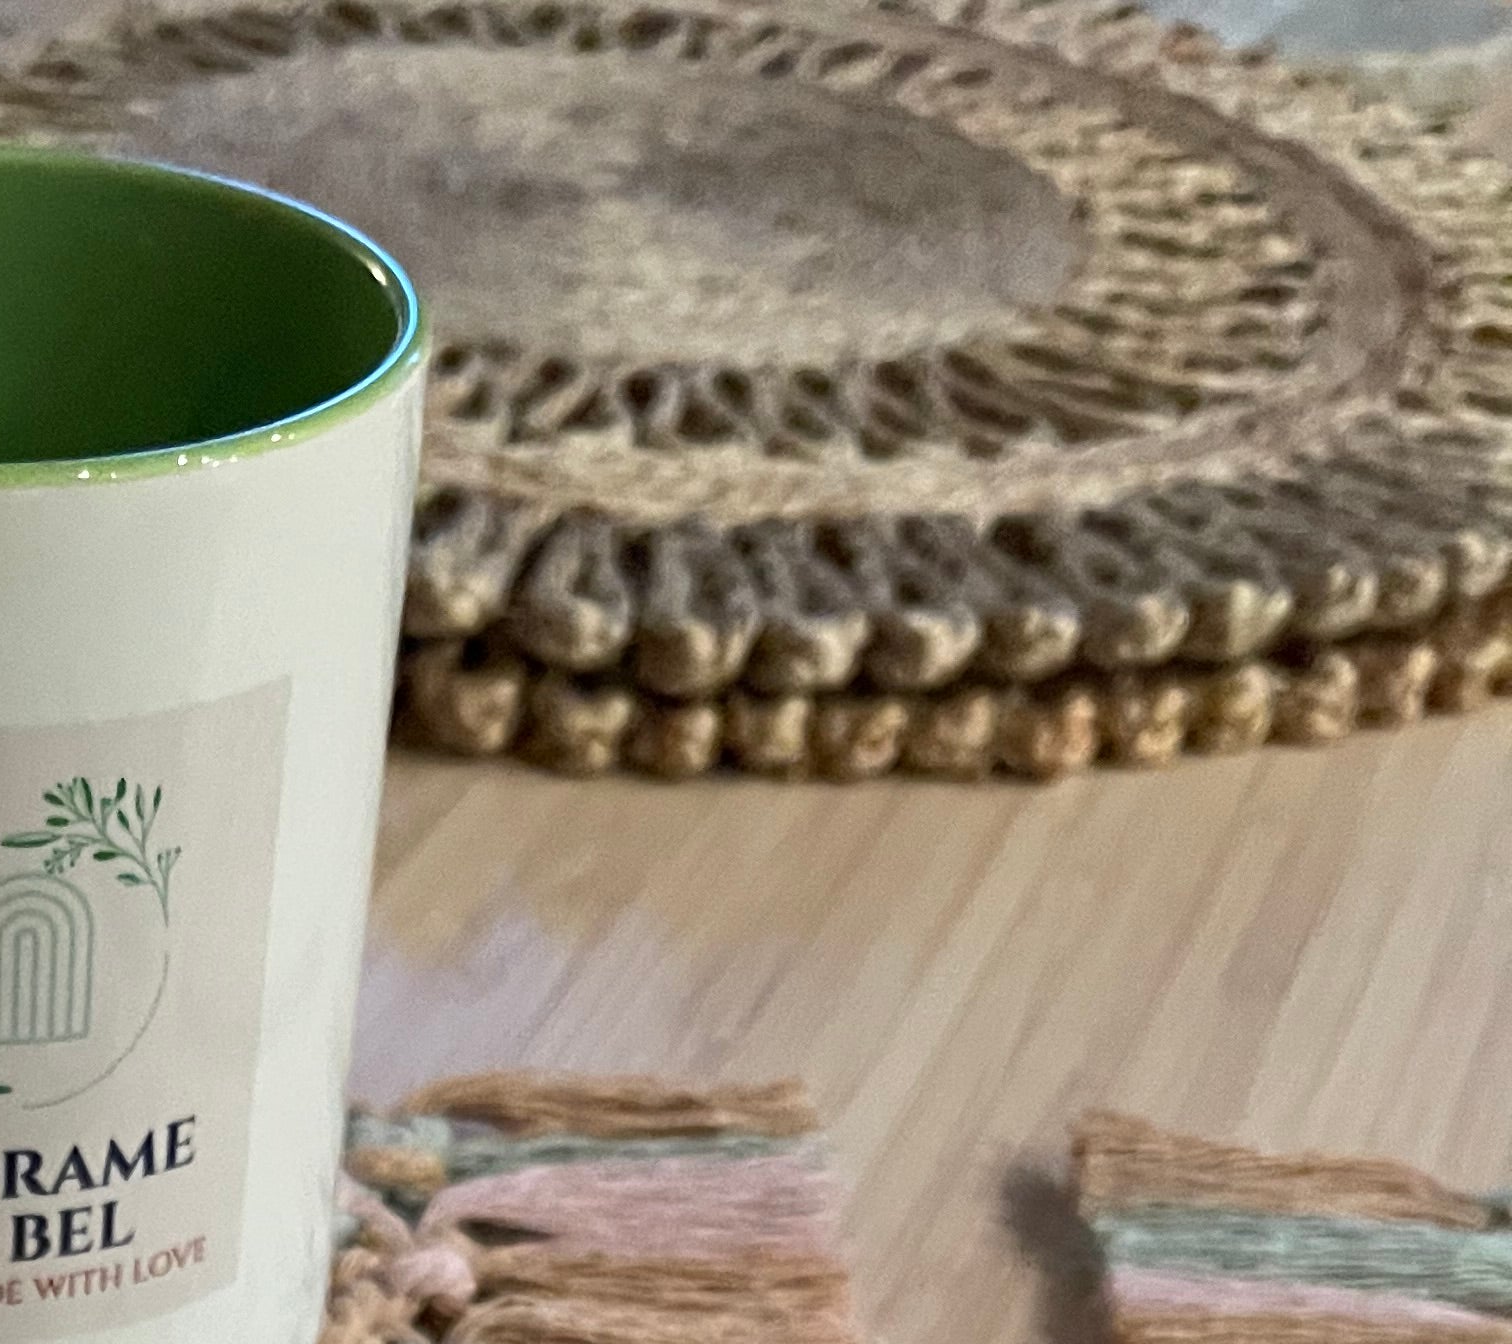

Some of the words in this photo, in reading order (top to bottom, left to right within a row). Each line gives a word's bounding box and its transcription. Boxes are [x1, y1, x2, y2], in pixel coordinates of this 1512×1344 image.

[10, 1201, 137, 1263] BEL
[32, 1262, 124, 1303] WITH
[132, 1236, 207, 1283] LOVE
